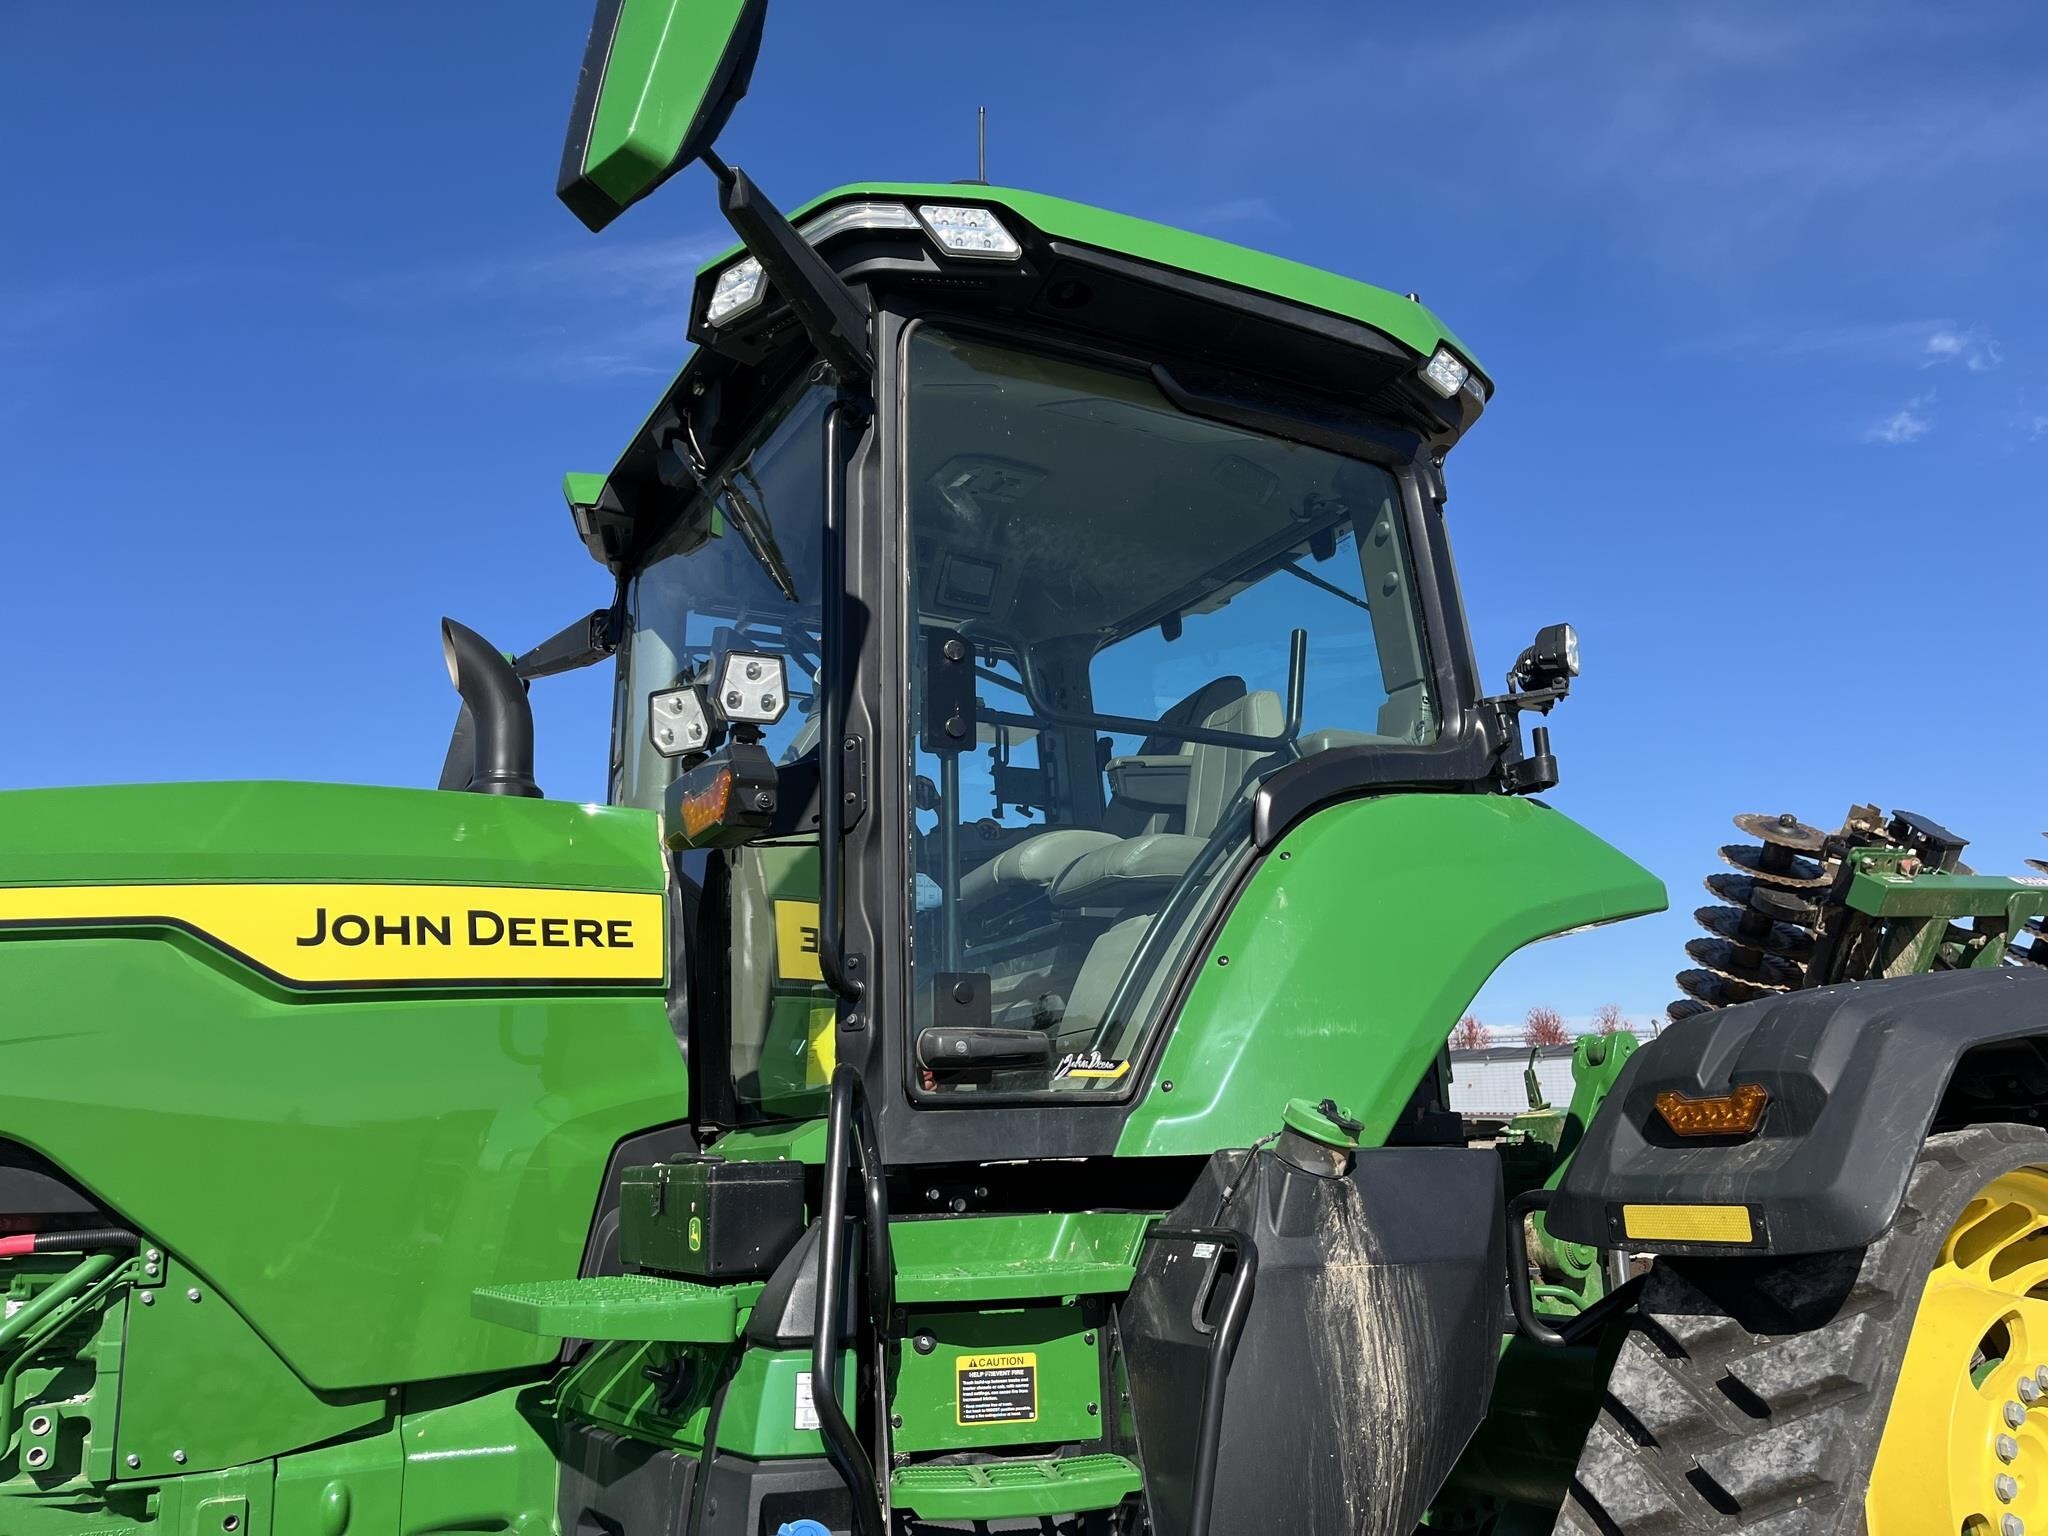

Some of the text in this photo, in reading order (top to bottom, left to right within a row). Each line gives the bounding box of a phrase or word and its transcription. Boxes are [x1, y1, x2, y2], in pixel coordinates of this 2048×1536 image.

[296, 908, 634, 948] JOHN DEERE
[1053, 1051, 1115, 1080] John Deere
[978, 1356, 1024, 1367] CAUTION
